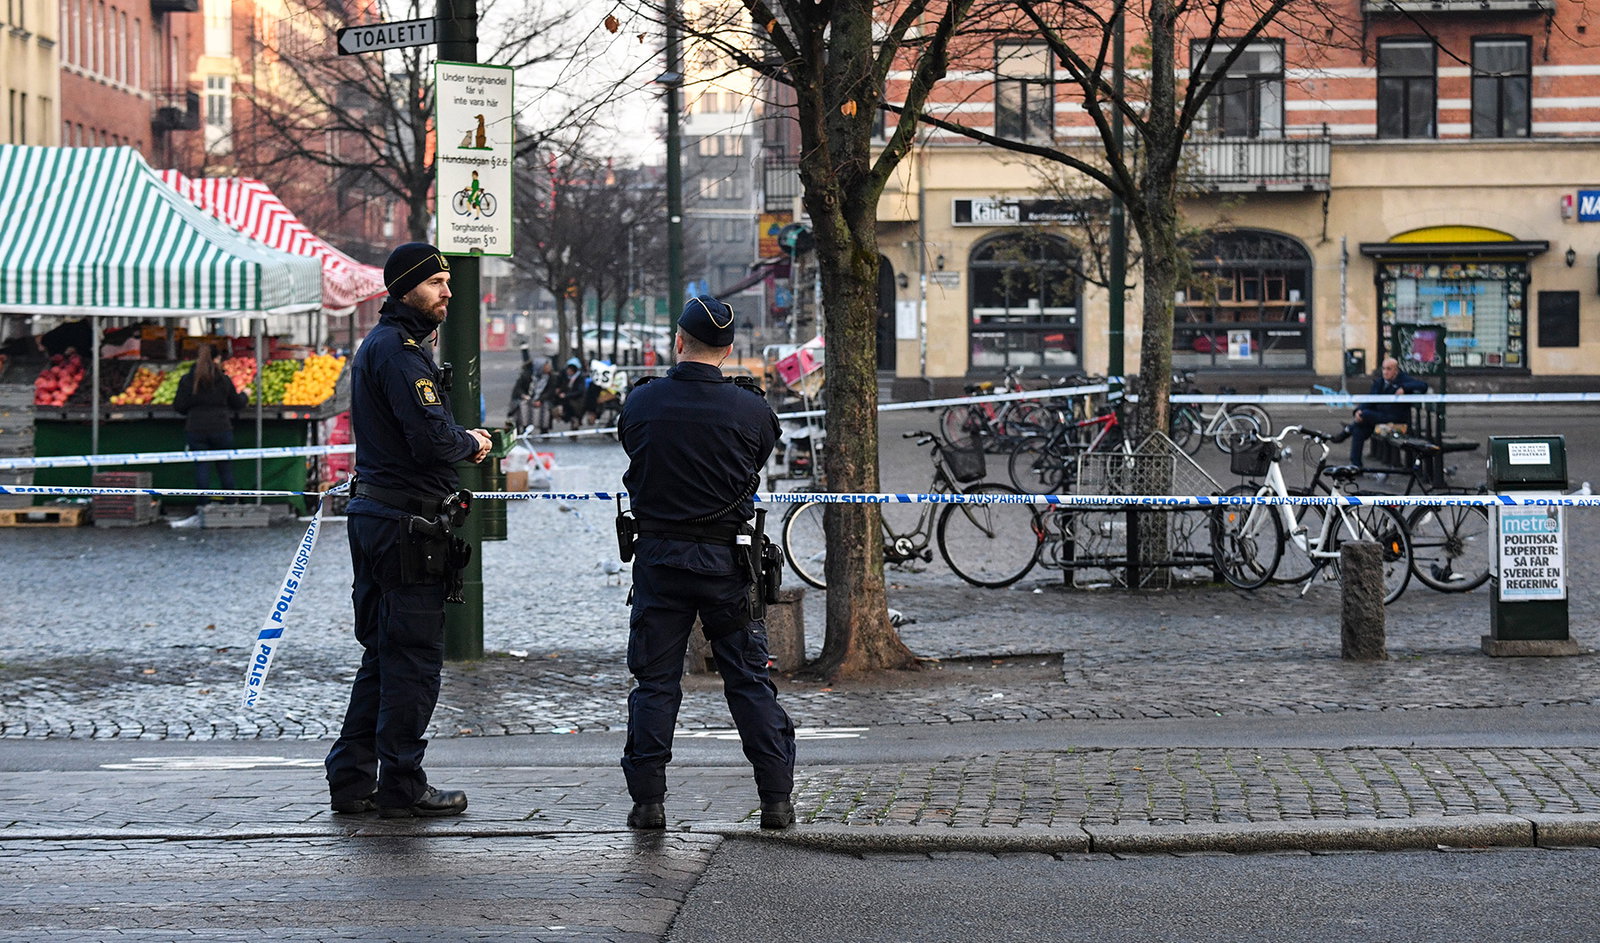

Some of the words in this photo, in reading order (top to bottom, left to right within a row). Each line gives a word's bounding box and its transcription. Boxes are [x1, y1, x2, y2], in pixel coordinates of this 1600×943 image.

[354, 23, 427, 48] TOALETT
[442, 72, 465, 82] Under
[467, 75, 507, 86] torghandel
[478, 86, 485, 95] vi
[454, 96, 467, 105] inte
[486, 98, 499, 107] här
[442, 154, 490, 166] Hundstadgan
[453, 236, 481, 245] stadgan
[917, 494, 965, 503] POLIS
[1218, 496, 1266, 505] POLIS
[1505, 516, 1557, 532] metro
[1504, 534, 1558, 545] POLITISKA
[1504, 546, 1558, 556] EXPERTER:
[1503, 568, 1544, 578] SVERIGE
[1547, 568, 1560, 578] EN
[1506, 579, 1558, 589] REGERING
[271, 578, 299, 624] POLIS
[249, 643, 272, 687] POLIS
